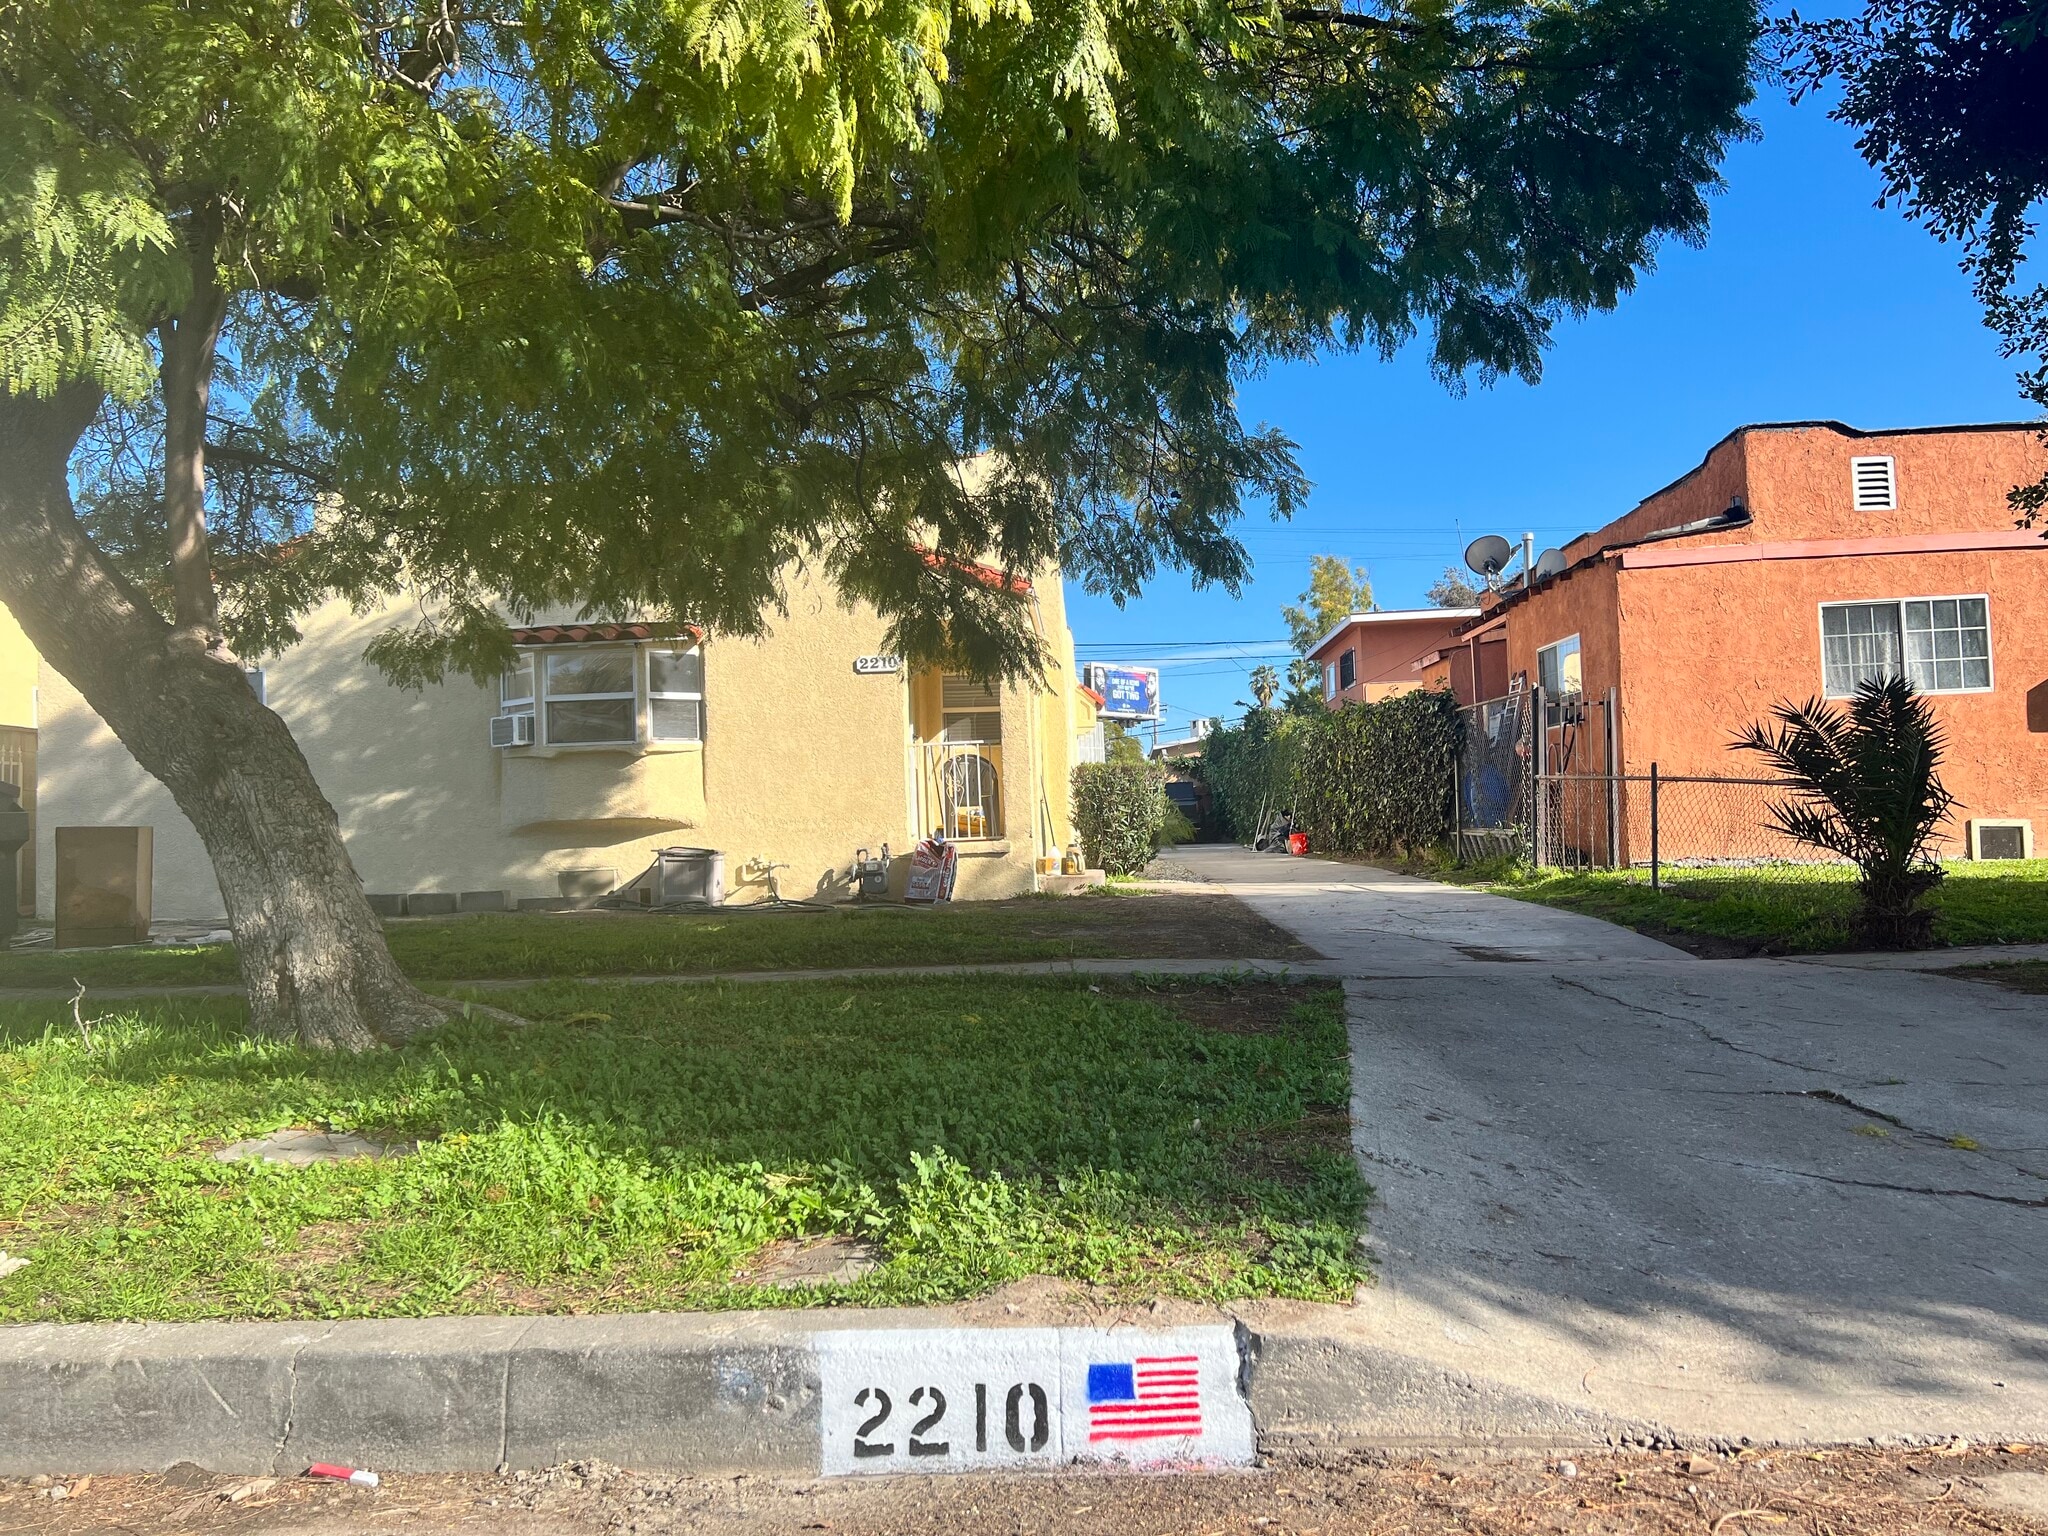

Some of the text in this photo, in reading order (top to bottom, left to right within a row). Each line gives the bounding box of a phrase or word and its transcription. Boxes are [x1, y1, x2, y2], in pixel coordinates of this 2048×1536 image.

[860, 657, 897, 669] 2210
[1112, 690, 1140, 701] GOT TWO
[854, 1382, 1049, 1457] 2210
